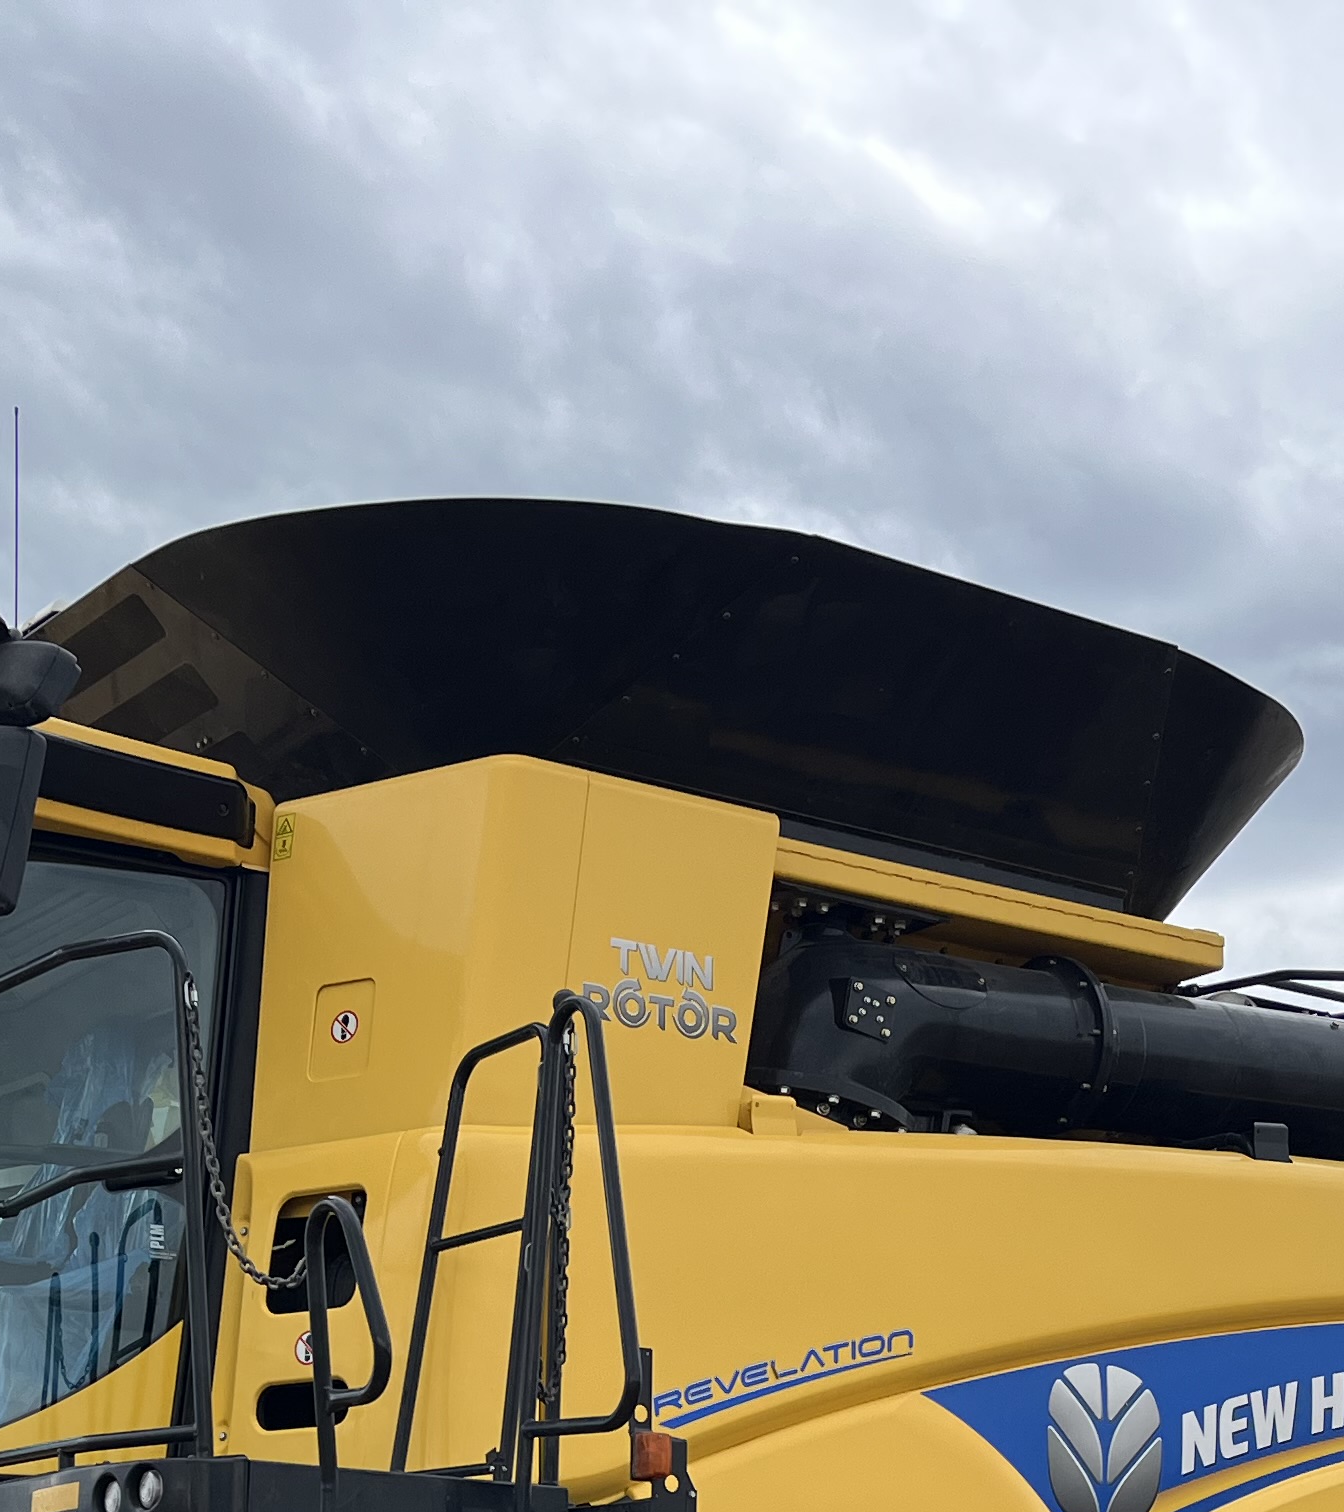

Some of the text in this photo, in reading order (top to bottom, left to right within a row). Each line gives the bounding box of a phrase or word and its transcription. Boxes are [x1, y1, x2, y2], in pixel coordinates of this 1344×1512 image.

[609, 936, 713, 991] TWIN
[582, 977, 738, 1044] ROTOR
[149, 1223, 165, 1250] PLM
[653, 1328, 914, 1417] REVELATION
[1181, 1381, 1299, 1475] NEW
